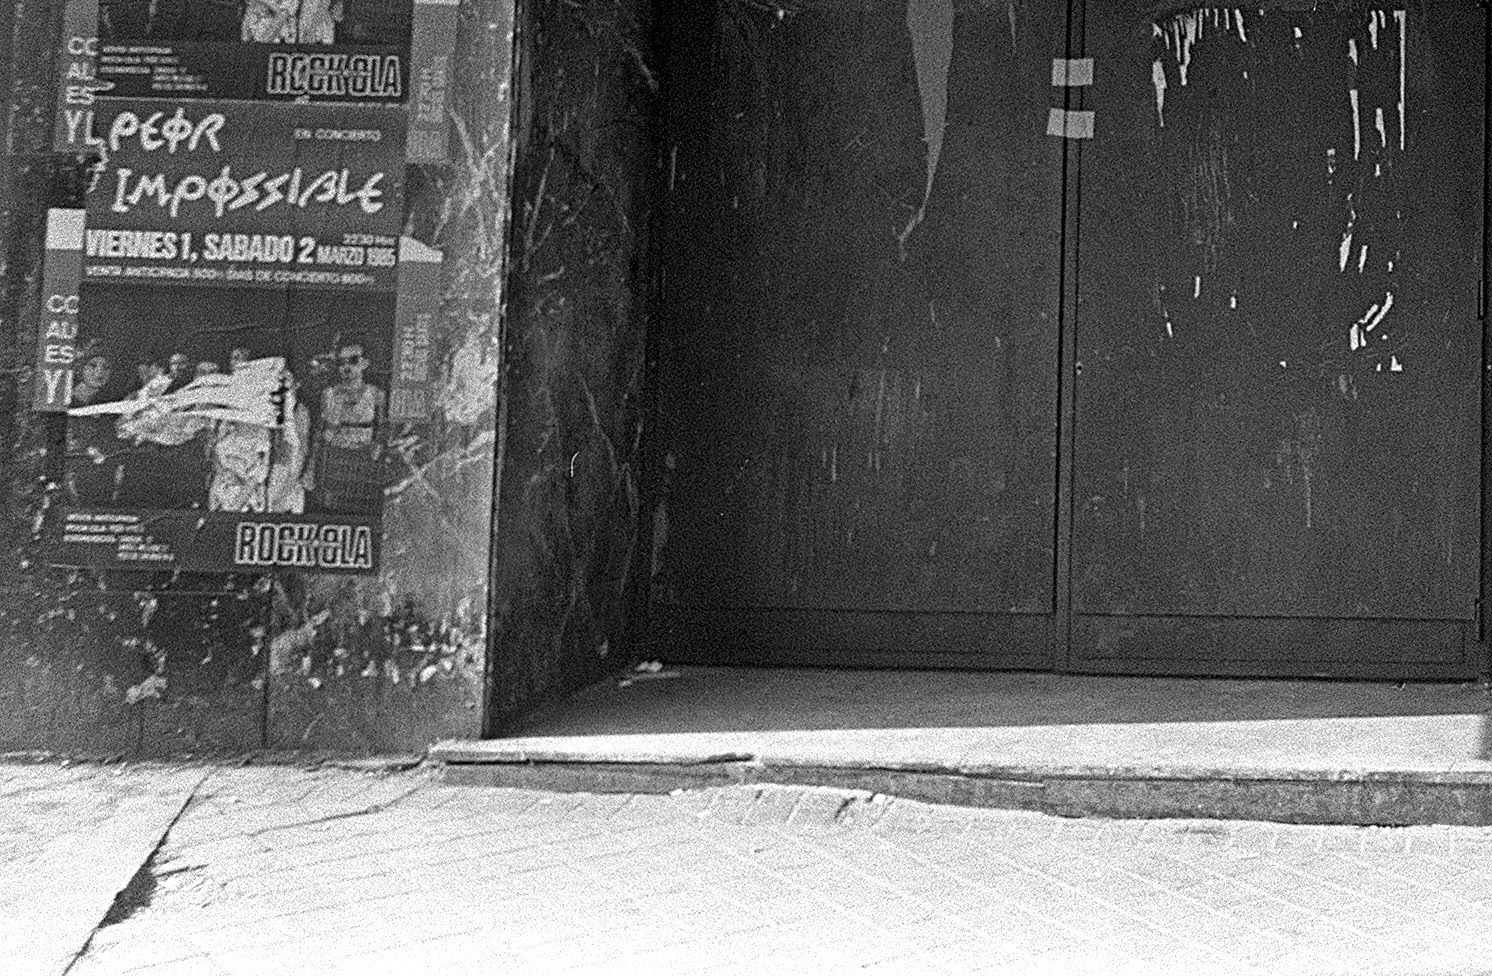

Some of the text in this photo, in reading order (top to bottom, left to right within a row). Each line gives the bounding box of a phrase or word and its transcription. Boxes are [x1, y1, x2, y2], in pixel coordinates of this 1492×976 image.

[86, 229, 178, 259] VIERNES
[203, 233, 295, 263] SABADO
[297, 236, 316, 265] 2
[317, 245, 364, 266] MARZO
